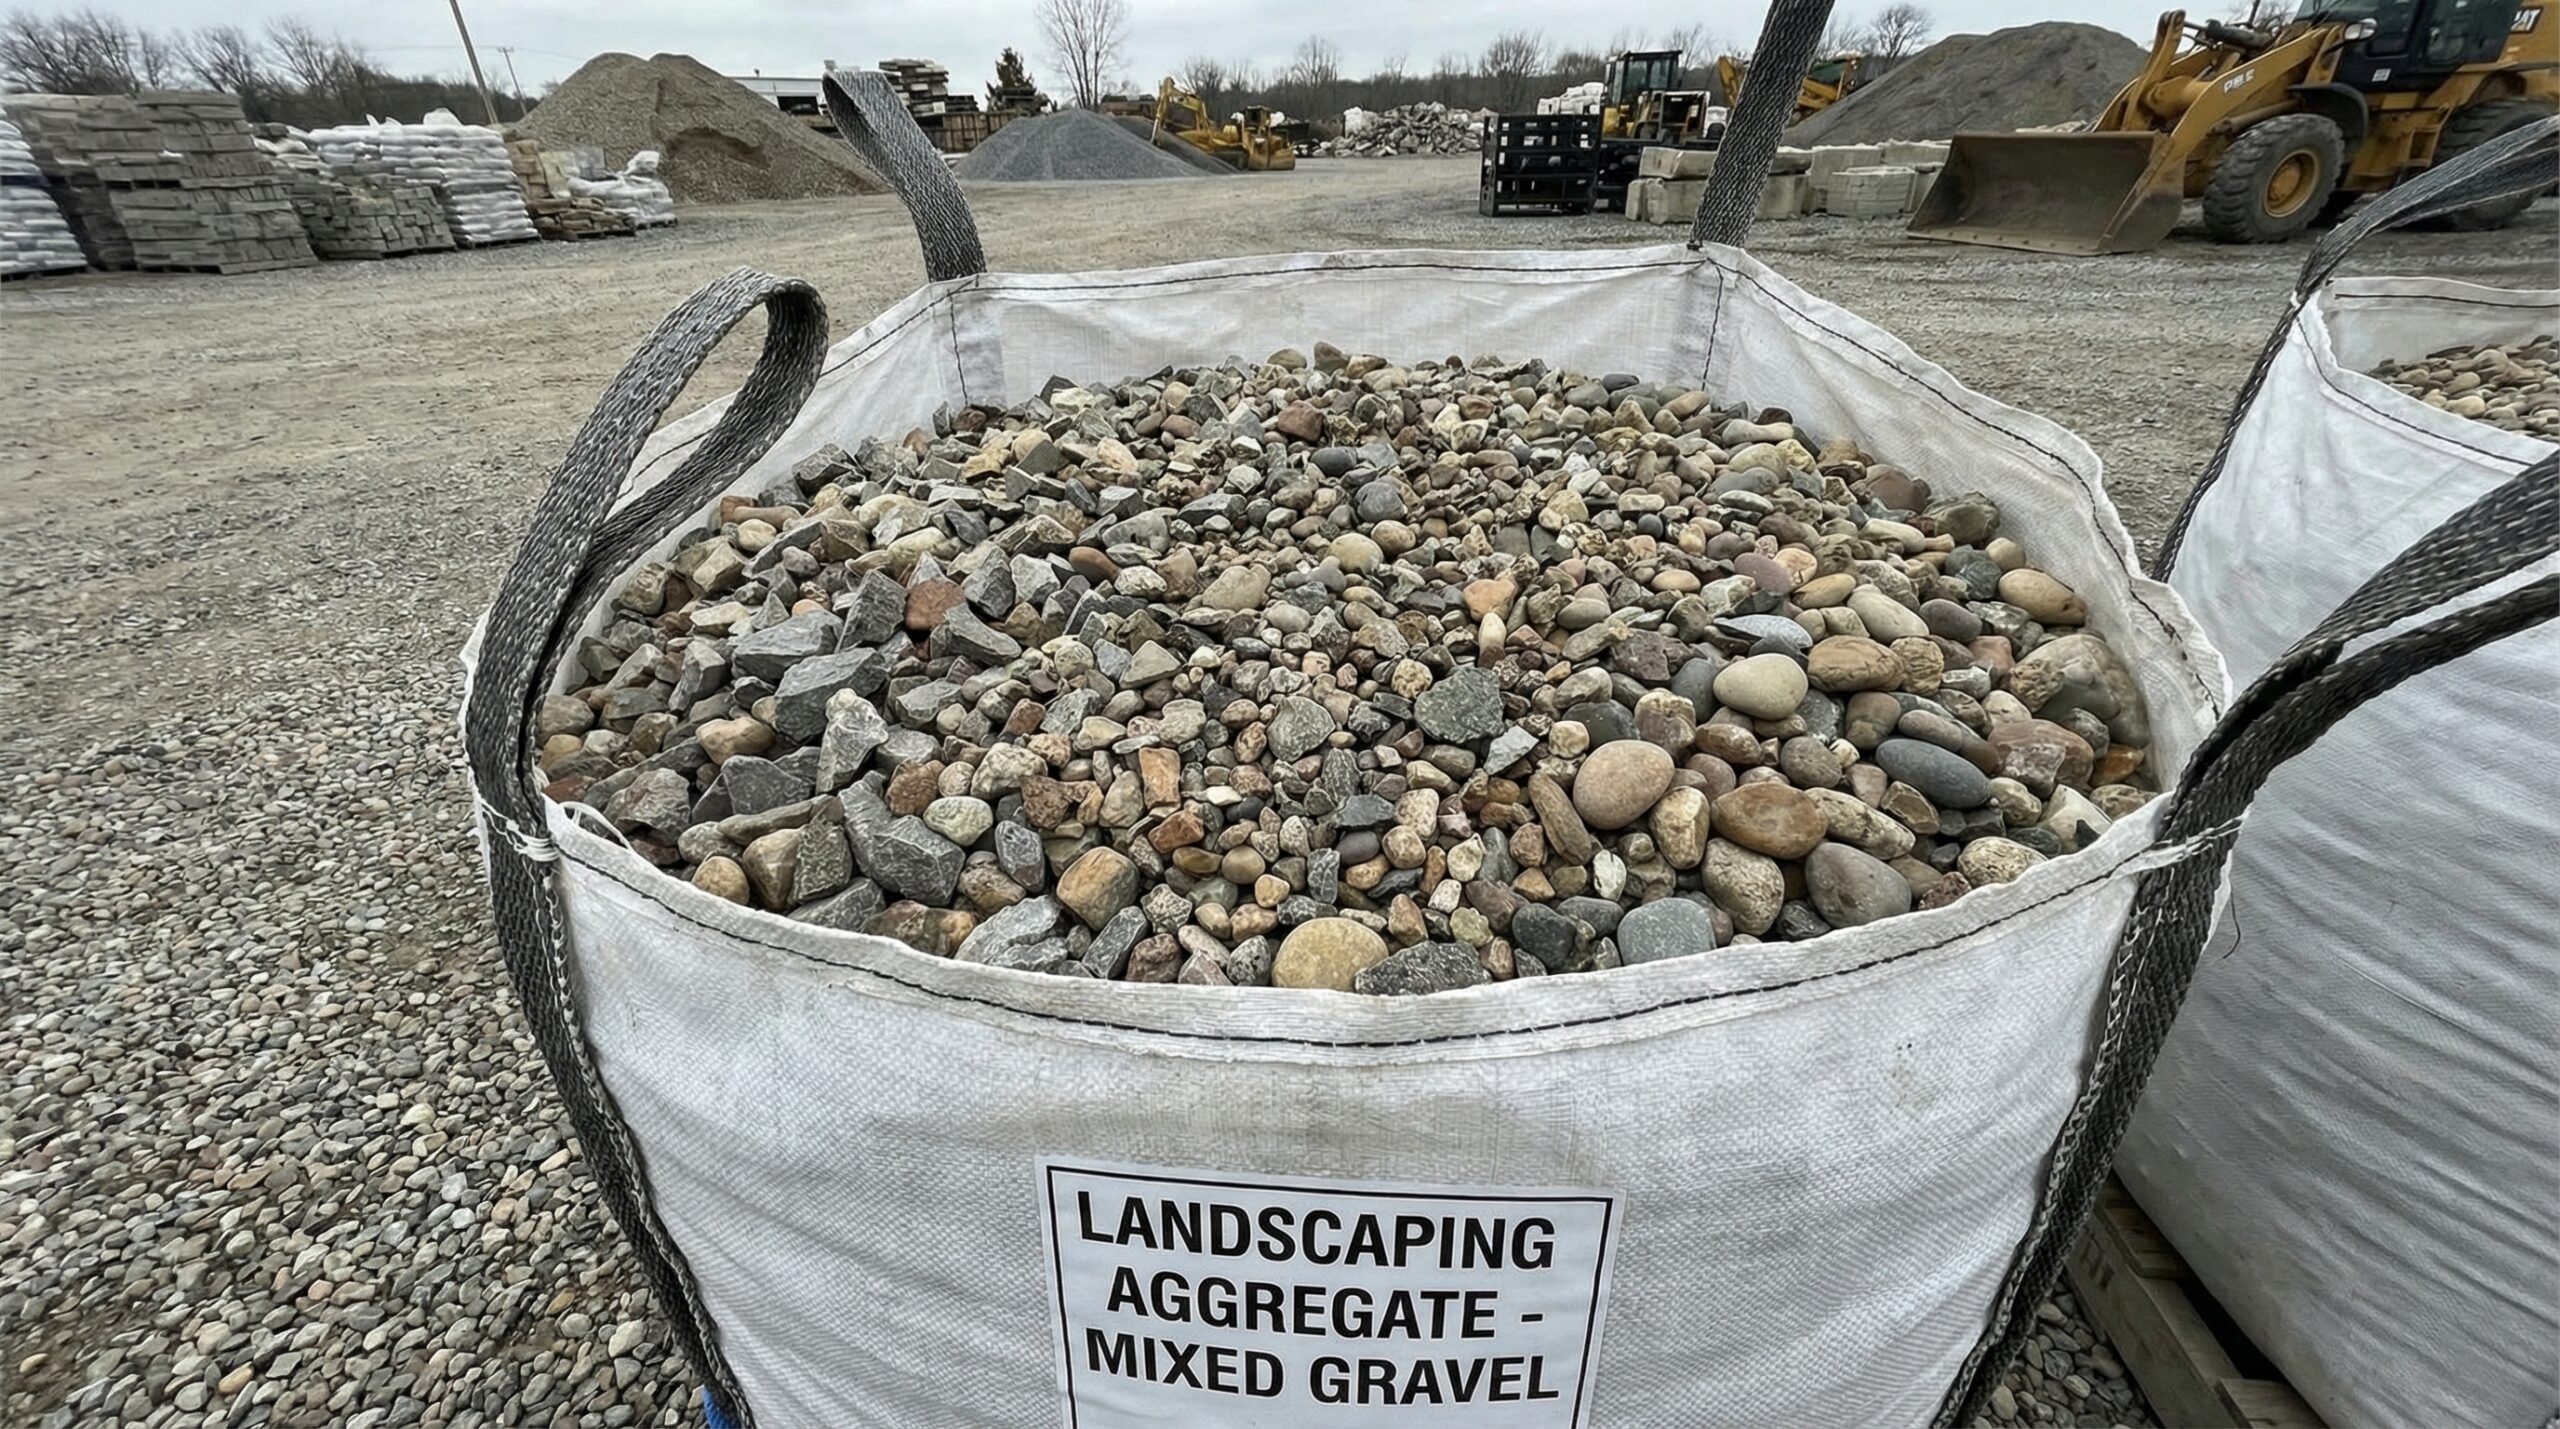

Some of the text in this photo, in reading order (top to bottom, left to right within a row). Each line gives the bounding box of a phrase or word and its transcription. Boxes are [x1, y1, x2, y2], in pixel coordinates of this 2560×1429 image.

[1077, 1190, 1555, 1270] LANDSCAPING
[1106, 1266, 1498, 1339] AGGREGATE
[1085, 1327, 1559, 1405] MIXED GRAVEL
